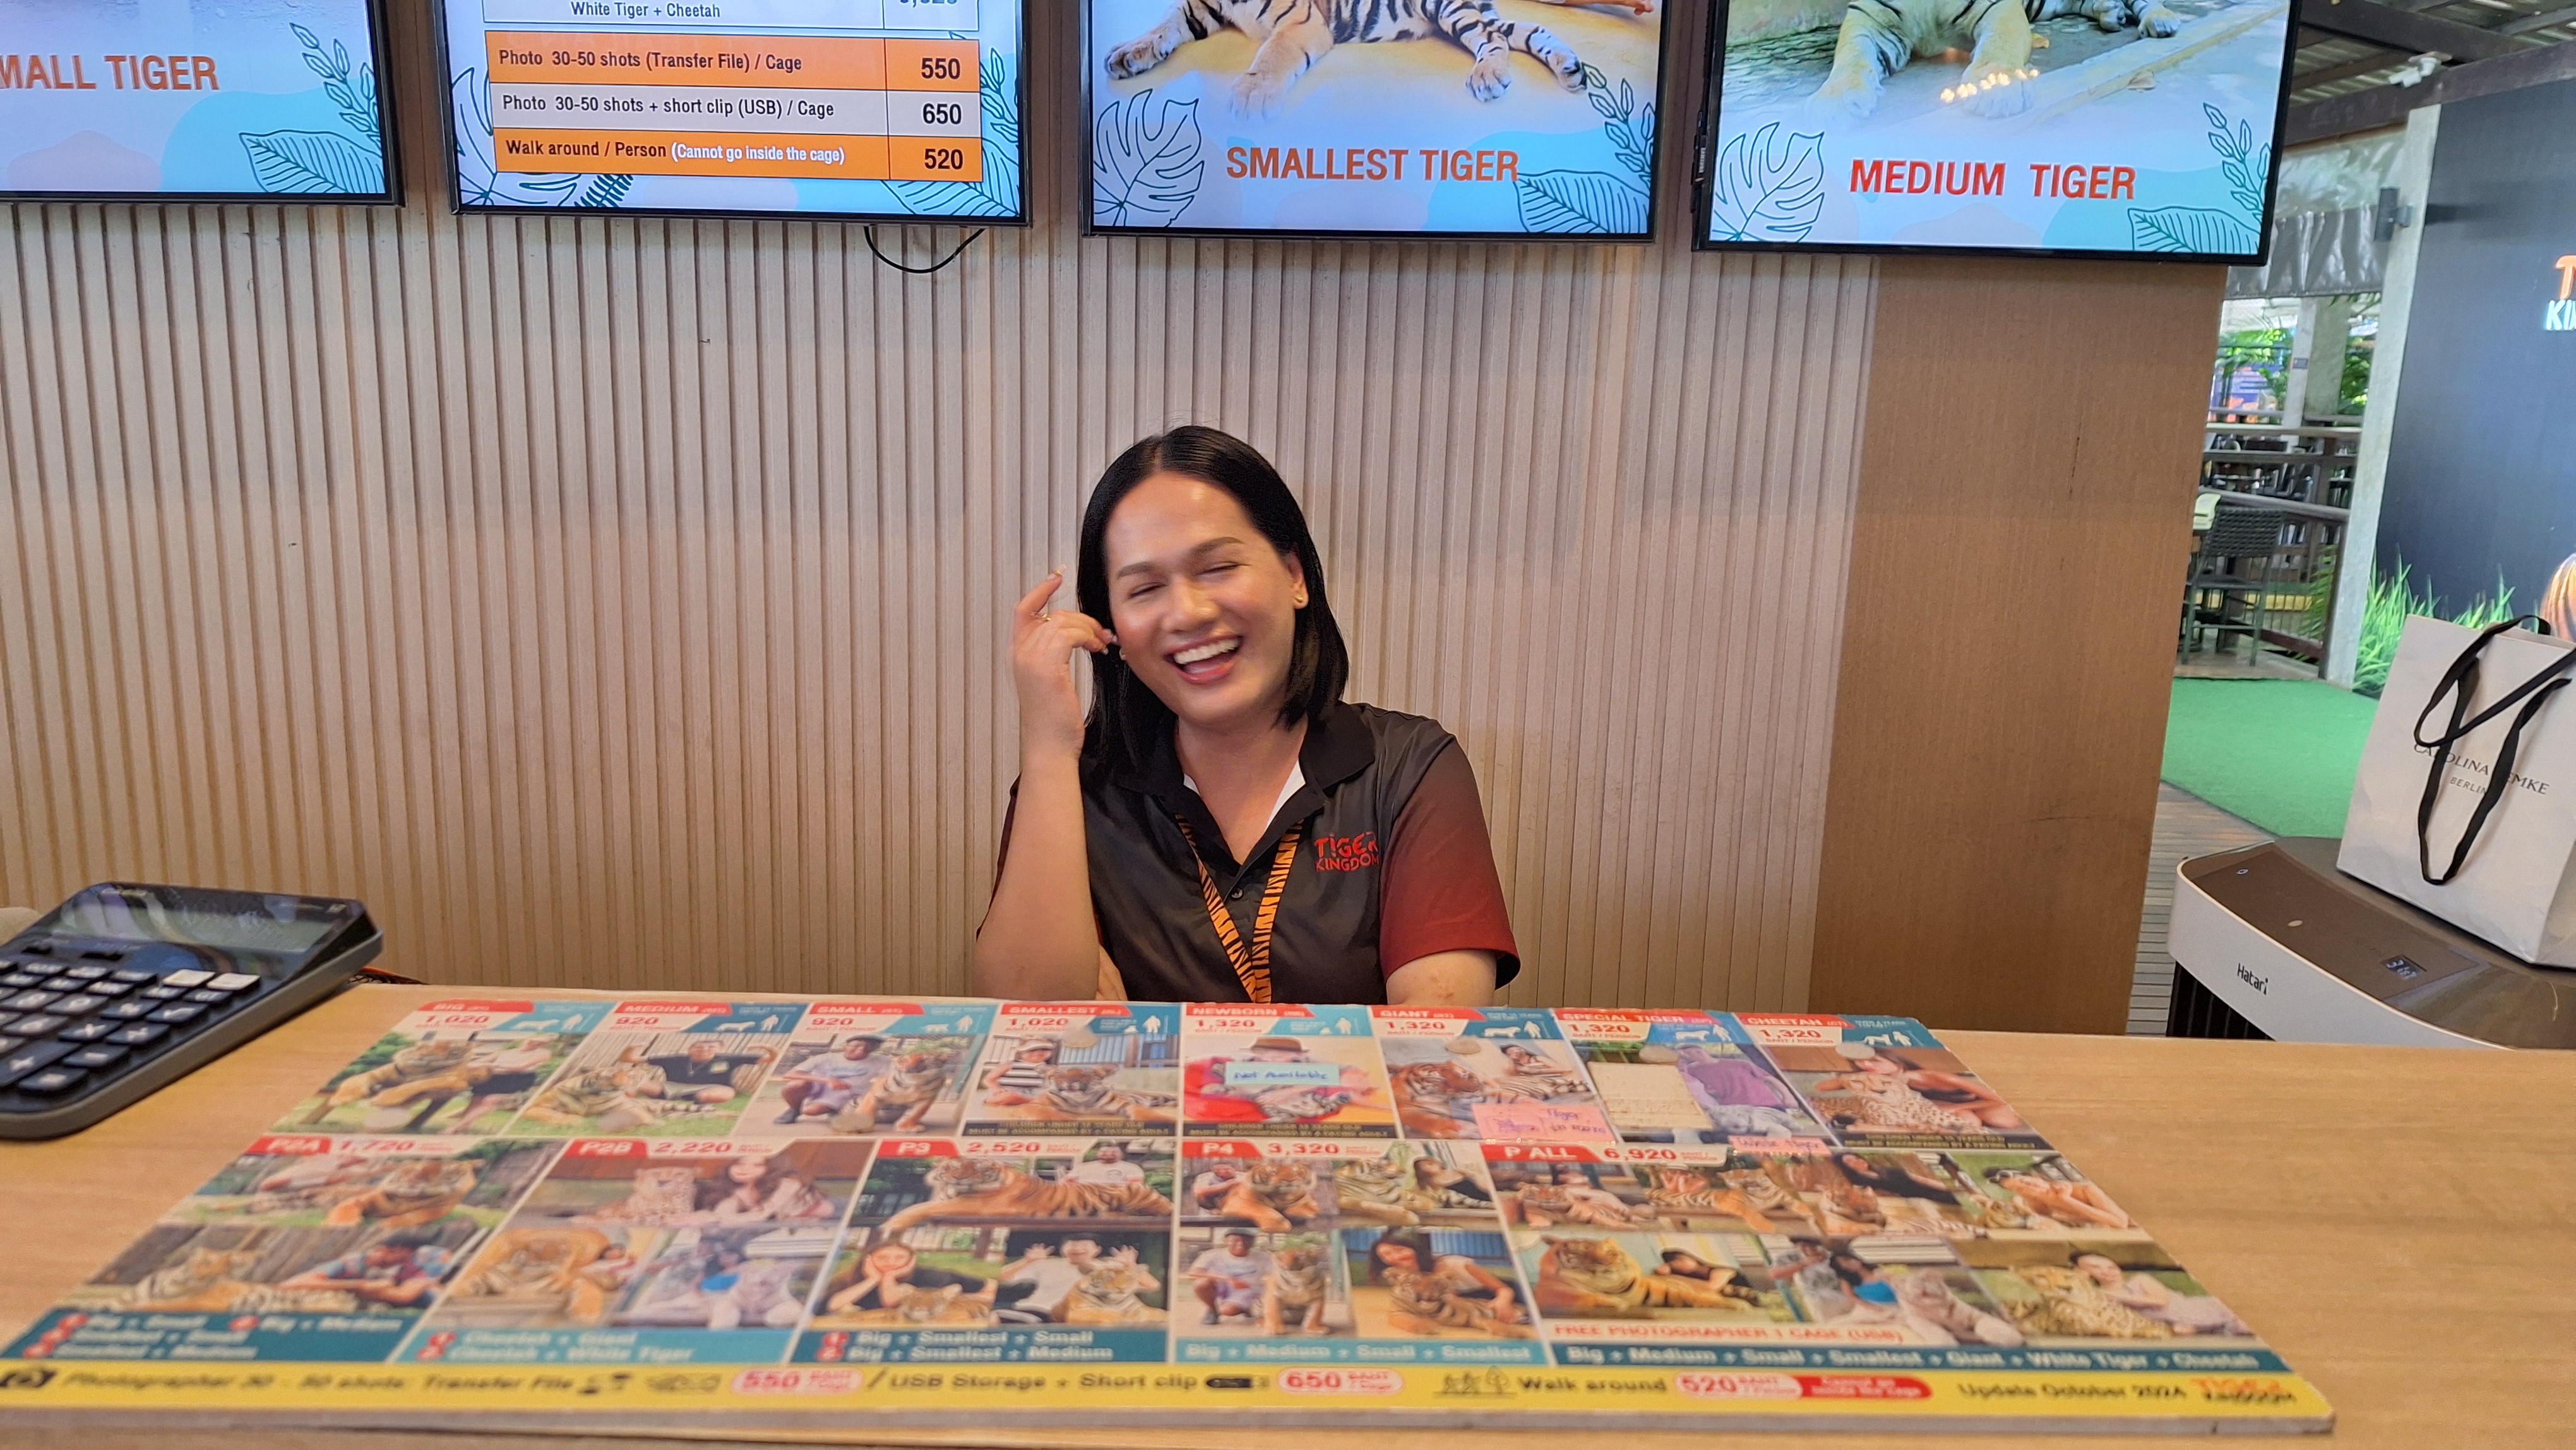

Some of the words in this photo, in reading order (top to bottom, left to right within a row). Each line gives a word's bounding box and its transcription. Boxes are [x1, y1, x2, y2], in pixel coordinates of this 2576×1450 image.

[571, 2, 611, 16] White
[615, 3, 649, 19] Tiger
[653, 7, 662, 16] +
[667, 3, 721, 18] Cheetah
[499, 50, 543, 66] Photo
[552, 51, 595, 67] 30-50
[600, 52, 641, 68] shots
[646, 52, 713, 71] (Transfer
[718, 52, 751, 74] File)
[754, 54, 761, 70] /
[765, 54, 802, 74] Cage
[921, 57, 960, 80] 550
[104, 55, 220, 90] TIGER
[503, 95, 547, 111] Photo
[556, 96, 599, 112] 30-50
[604, 97, 644, 112] shots
[648, 103, 659, 112] +
[664, 98, 703, 114] short
[707, 99, 734, 117] clip
[738, 99, 783, 119] (USB)
[787, 100, 794, 116] /
[797, 100, 835, 119] Cage
[922, 103, 962, 125] 650
[506, 139, 544, 155] Walk
[548, 140, 600, 157] around
[604, 141, 611, 157] /
[615, 141, 667, 158] Person
[671, 142, 724, 163] (Cannot
[727, 148, 742, 163] go
[746, 145, 784, 160] inside
[787, 146, 808, 161] the
[810, 147, 845, 165] cage)
[924, 148, 963, 170] 520
[1227, 146, 1409, 181] SMALLEST
[1420, 149, 1519, 183] TIGER
[1849, 159, 2006, 196] MEDIUM
[2030, 164, 2137, 200] TIGER
[2414, 743, 2489, 776] CAOLINA
[1315, 853, 1380, 872] KINGDOM
[2237, 962, 2269, 995] Hatari
[426, 1015, 491, 1024] 1,020
[1192, 1008, 1278, 1016] NEWBORN
[1563, 1013, 1632, 1021] SPECIAL
[1636, 1015, 1685, 1023] TIGER
[615, 1016, 660, 1025] 920
[811, 1017, 855, 1026] 920
[1009, 1017, 1069, 1027] 1,020
[1195, 1019, 1256, 1029] 1,320
[1386, 1021, 1446, 1031] 1,320
[1748, 1018, 1823, 1026] CHEETAH
[1569, 1024, 1631, 1034] 1,320
[1759, 1029, 1822, 1040] 1,320
[654, 1142, 733, 1154] 2,220
[897, 1142, 931, 1155] P3
[966, 1142, 1041, 1154] 2,520
[1202, 1142, 1234, 1155] P4
[1268, 1142, 1340, 1156] 3,320
[1505, 1146, 1521, 1159] P
[1529, 1147, 1577, 1160] ALL
[1604, 1148, 1677, 1161] 6,920
[919, 1331, 1009, 1346] Smallest
[1034, 1330, 1094, 1346] Small
[1025, 1346, 1113, 1361] Medium
[1246, 1344, 1330, 1359] Medium
[743, 1370, 801, 1389] 550
[951, 1373, 1046, 1391] Storage
[1080, 1372, 1148, 1388] Short
[1154, 1372, 1198, 1391] clip
[1287, 1371, 1342, 1389] 650
[1681, 1375, 1736, 1393] 520
